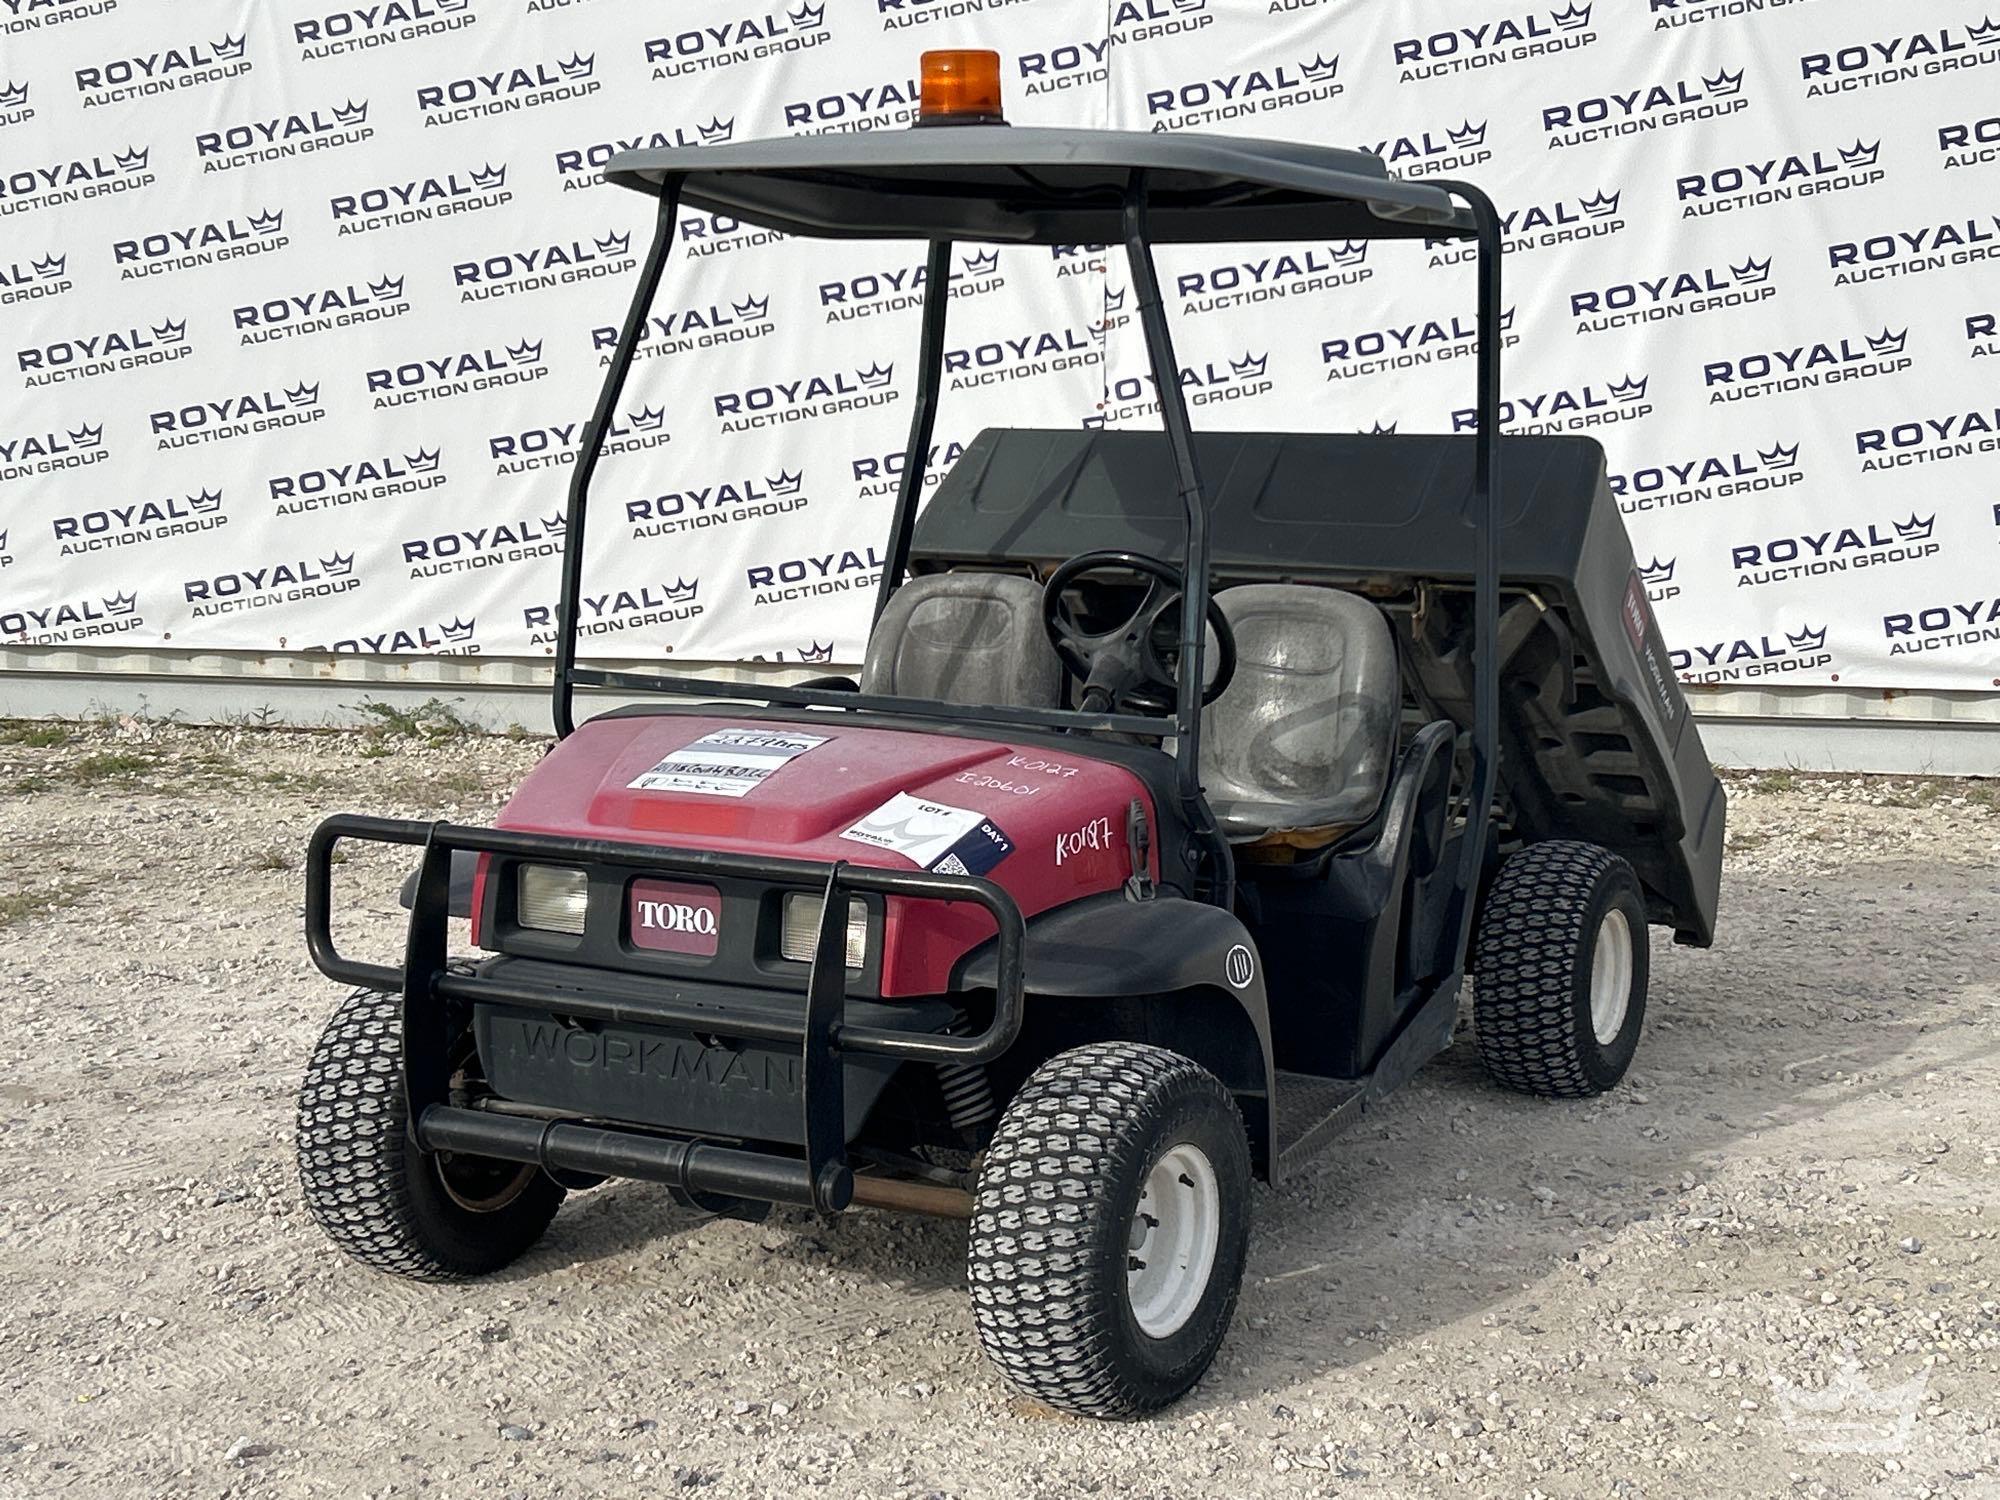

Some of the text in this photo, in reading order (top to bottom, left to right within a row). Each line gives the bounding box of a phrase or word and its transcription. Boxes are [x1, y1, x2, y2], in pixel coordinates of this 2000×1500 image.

[45, 0, 117, 25] GROUP
[294, 0, 435, 44] ROYAL
[884, 0, 983, 31] AUCTION
[1132, 15, 1213, 41] GROUP
[1654, 0, 1764, 31] AUCTION
[302, 15, 476, 61] AUCTION GROUP
[645, 15, 788, 63] ROYAL
[652, 32, 831, 80] AUCTION GROUP
[1019, 39, 1108, 78] ROY
[1393, 15, 1551, 65] ROYAL
[1400, 33, 1597, 83] AUCTION GROUP
[1801, 29, 1966, 80] ROYAL
[75, 46, 212, 91] ROYAL
[83, 62, 252, 108] AUCTION GROUP
[417, 64, 559, 110] ROYAL
[1026, 67, 1107, 96] AUCTIO
[1807, 50, 2000, 98] AUCTION GROU
[425, 81, 601, 128] AUCTION GROUP
[1147, 67, 1299, 115] ROYAL
[1152, 84, 1343, 133] AUCTION GROUP
[1543, 81, 1702, 131] ROYAL
[196, 111, 334, 156] ROYAL
[1549, 99, 1748, 150] AUCTION GROUP
[204, 128, 374, 174] AUCTION GROUP
[1408, 150, 1492, 177] GROUP
[0, 157, 115, 196] OYAL
[1, 174, 155, 215] UCTION GROUP
[330, 175, 471, 219] ROYAL
[1676, 152, 1838, 201] ROYAL
[1683, 170, 1884, 219] AUCTION GROUP
[338, 192, 512, 236] AUCTION GROUP
[113, 220, 250, 264] ROYAL
[121, 237, 289, 280] AUCTION GROUP
[1429, 220, 1625, 268] AUCON GROUP
[1828, 220, 1993, 268] ROYAL
[453, 242, 595, 286] ROYAL
[461, 259, 636, 303] AUCTION GROUP
[1177, 251, 1329, 297] ROYAL
[1834, 245, 2000, 287] AUCTION GRO
[1, 281, 72, 304] GROUP
[233, 286, 369, 329] ROYAL
[827, 278, 1004, 323] AUCTION ROUP
[1184, 269, 1373, 315] AUCTION GROUP
[1570, 269, 1730, 317] ROYAL
[1577, 287, 1776, 335] AUCTION GROUP
[241, 303, 410, 346] AUCTION GROUP
[599, 323, 774, 367] ACTION GROUP
[1322, 317, 1475, 363] ROYAL
[17, 329, 153, 372] ROYAL
[25, 346, 192, 388] AUCTION GROUP
[366, 350, 508, 392] ROYAL
[944, 329, 1088, 373] ROYAL
[951, 349, 1105, 391] AUCTION GRO
[1327, 351, 1431, 381] AUCTION
[1704, 339, 1866, 386] ROYAL
[374, 367, 548, 409] AUCTION GROUP
[714, 373, 857, 417] ROYAL
[1192, 381, 1273, 406] GROUP
[1710, 358, 1912, 405] AUCTION GROUP
[150, 392, 286, 434] ROYAL
[158, 409, 325, 450] AUCTION GROUP
[721, 391, 899, 434] AUCTION GROUP
[1568, 404, 1652, 429] GROUP
[0, 433, 69, 463] YAL
[489, 418, 630, 459] ROYL
[1862, 442, 1972, 472] AUCTION
[37, 450, 109, 473] GROUP
[269, 458, 406, 499] ROYAL
[497, 447, 582, 476] AUCTIO
[276, 475, 446, 516] AUCTION GROUP
[626, 480, 766, 523] ROYAL
[1620, 472, 1804, 513] UCTION GROUP
[53, 499, 189, 540] ROYAL
[60, 516, 228, 556] AUCTION GROUP
[633, 498, 808, 539] AUCTION GROUP
[402, 522, 542, 563] ROYAL
[410, 538, 567, 579] AUCTION GROU
[1732, 525, 1893, 569] ROYAL
[184, 562, 320, 603] ROYAL
[1738, 543, 1940, 587] AUCTION GROUP
[192, 579, 360, 618] AUCTION GROUP
[755, 579, 849, 606] AUCTION
[0, 602, 104, 635] OYAL
[73, 618, 143, 639] GROUP
[530, 605, 703, 645] AUTION GROUP
[1668, 636, 1786, 671] OYAL
[1746, 654, 1832, 679] GROUP
[917, 804, 940, 815] LOT
[981, 824, 1008, 851] DAY 1
[521, 1023, 800, 1097] WORKMAN
